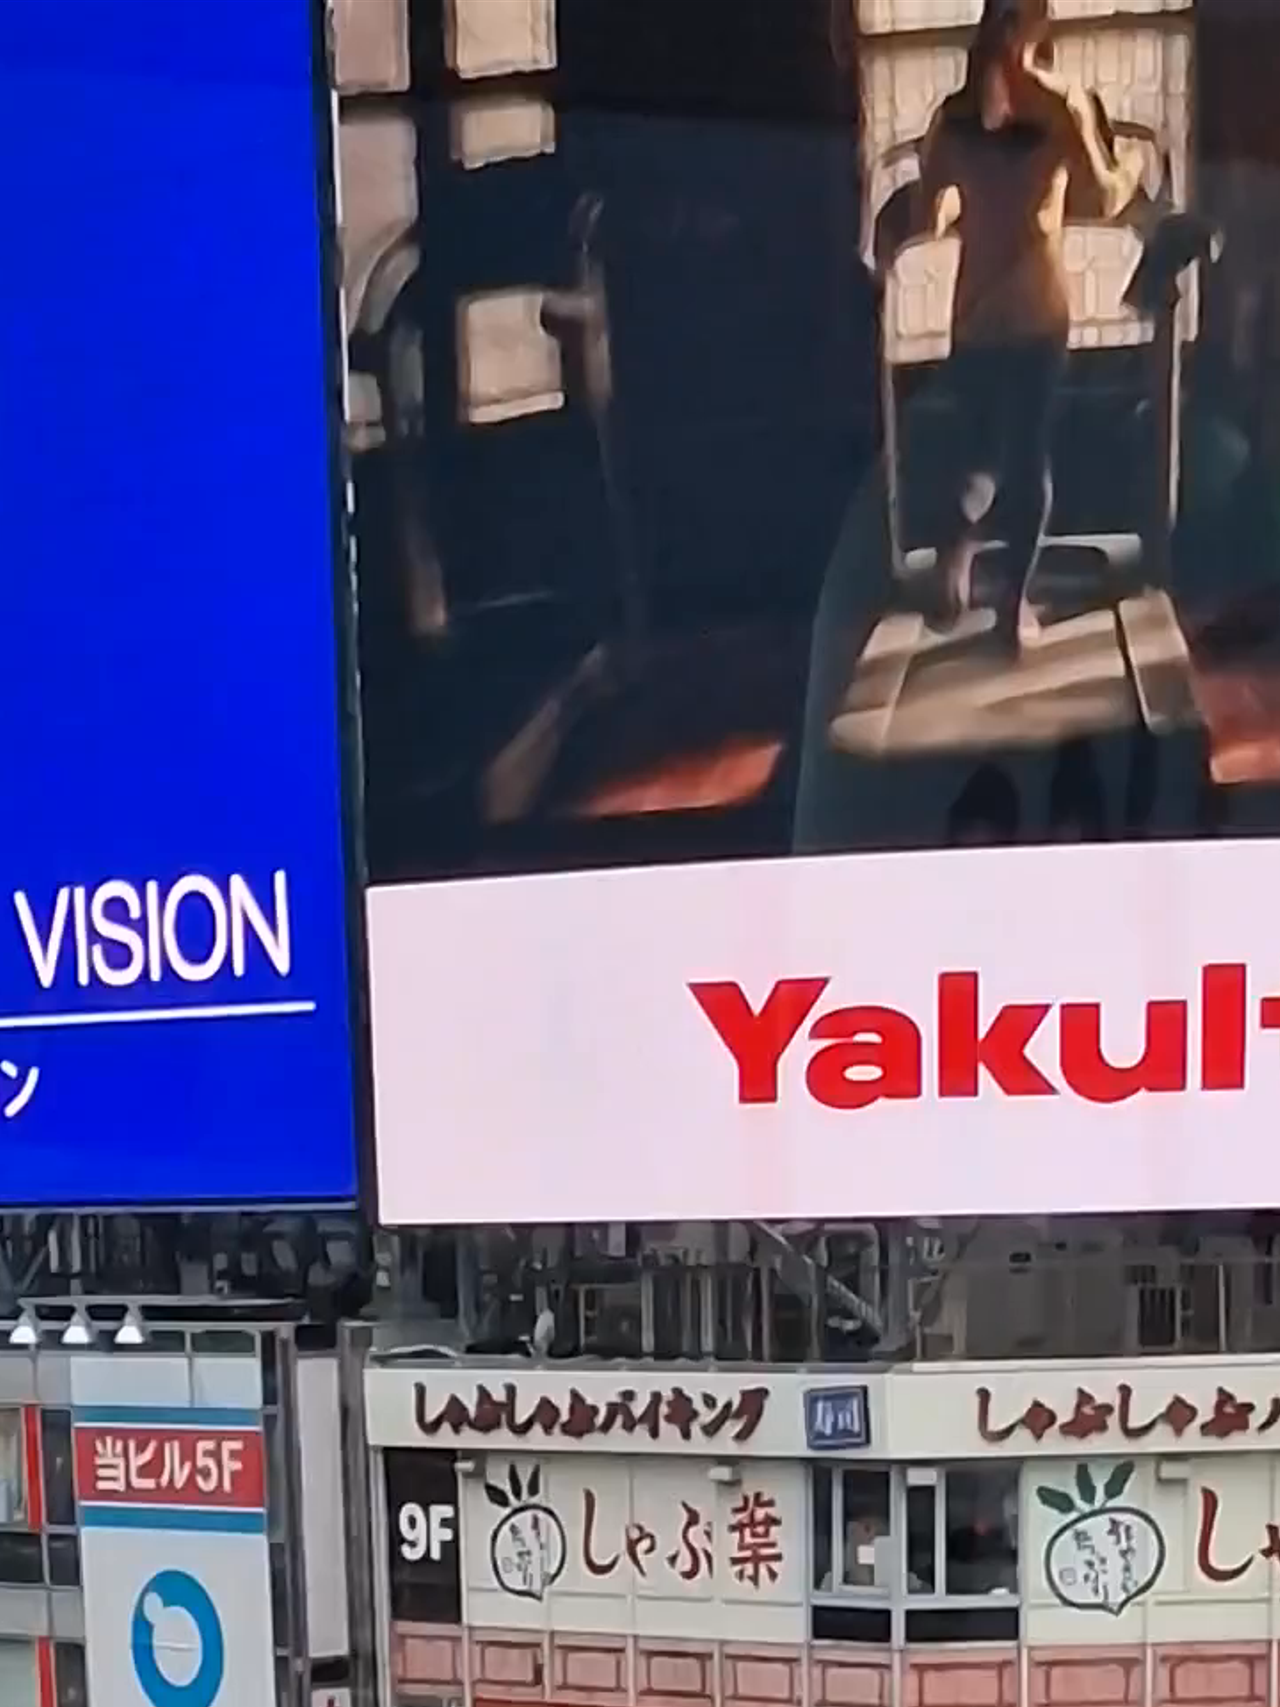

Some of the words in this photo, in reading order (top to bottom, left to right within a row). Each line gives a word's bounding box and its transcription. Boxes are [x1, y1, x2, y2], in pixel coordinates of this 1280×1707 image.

[14, 870, 292, 989] VISION
[93, 1435, 247, 1494] 当ビル5F
[398, 1502, 456, 1561] 9F
[581, 1487, 786, 1591] しゃぶ葉
